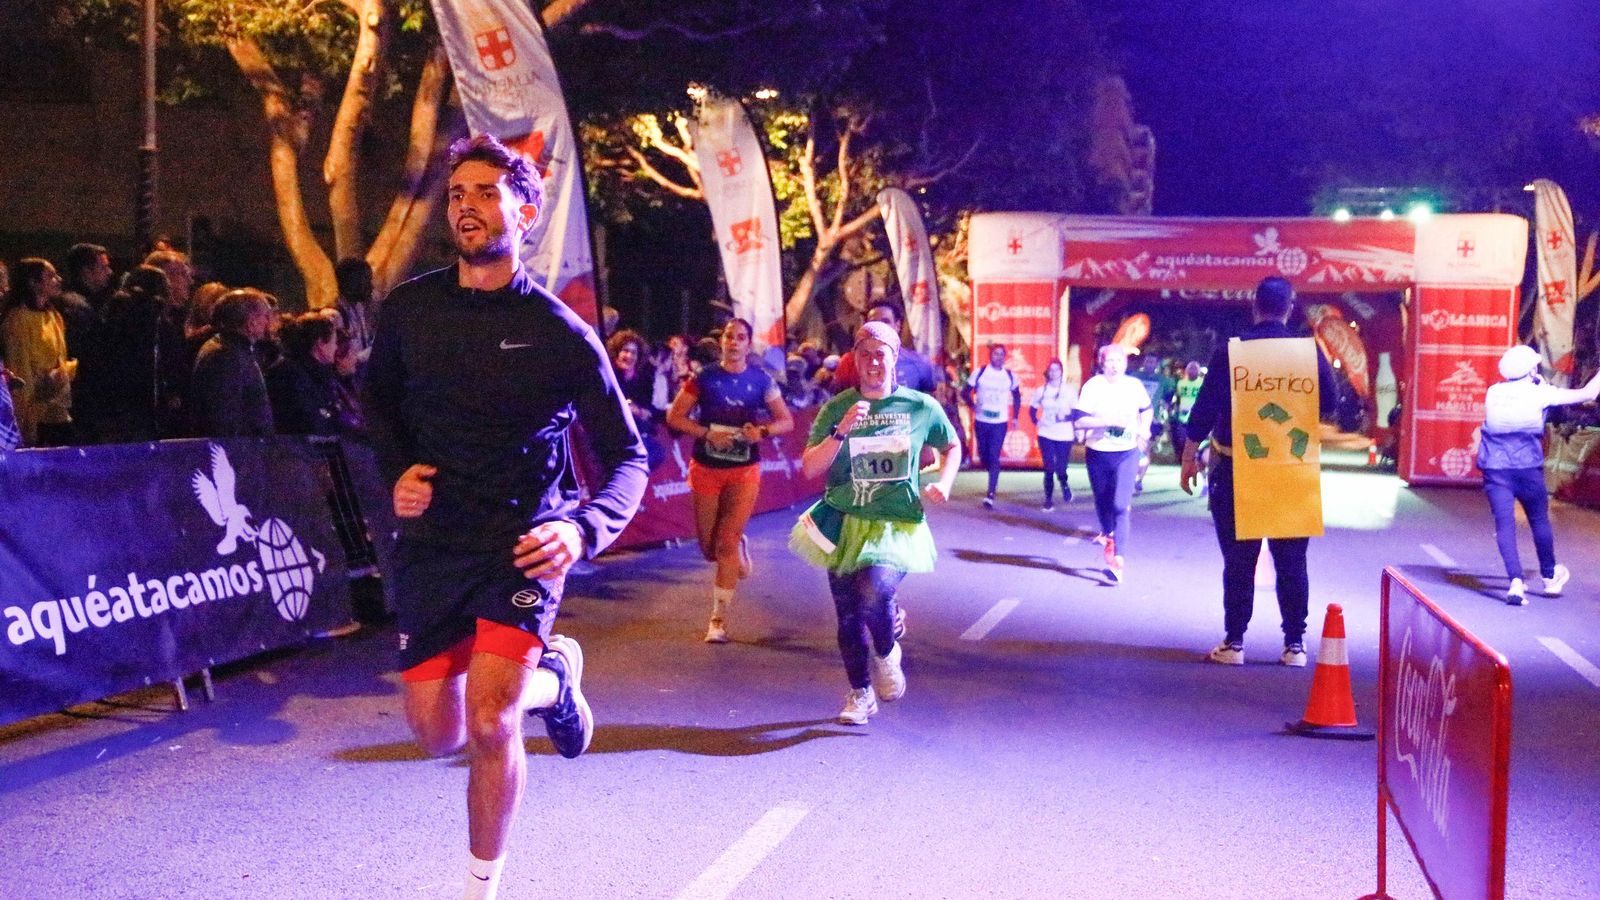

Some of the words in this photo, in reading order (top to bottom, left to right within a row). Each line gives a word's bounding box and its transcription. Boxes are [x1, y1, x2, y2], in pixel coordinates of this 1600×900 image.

[1155, 253, 1274, 269] aquéatacamos
[868, 458, 893, 474] 10
[3, 560, 263, 655] aquéatacamos
